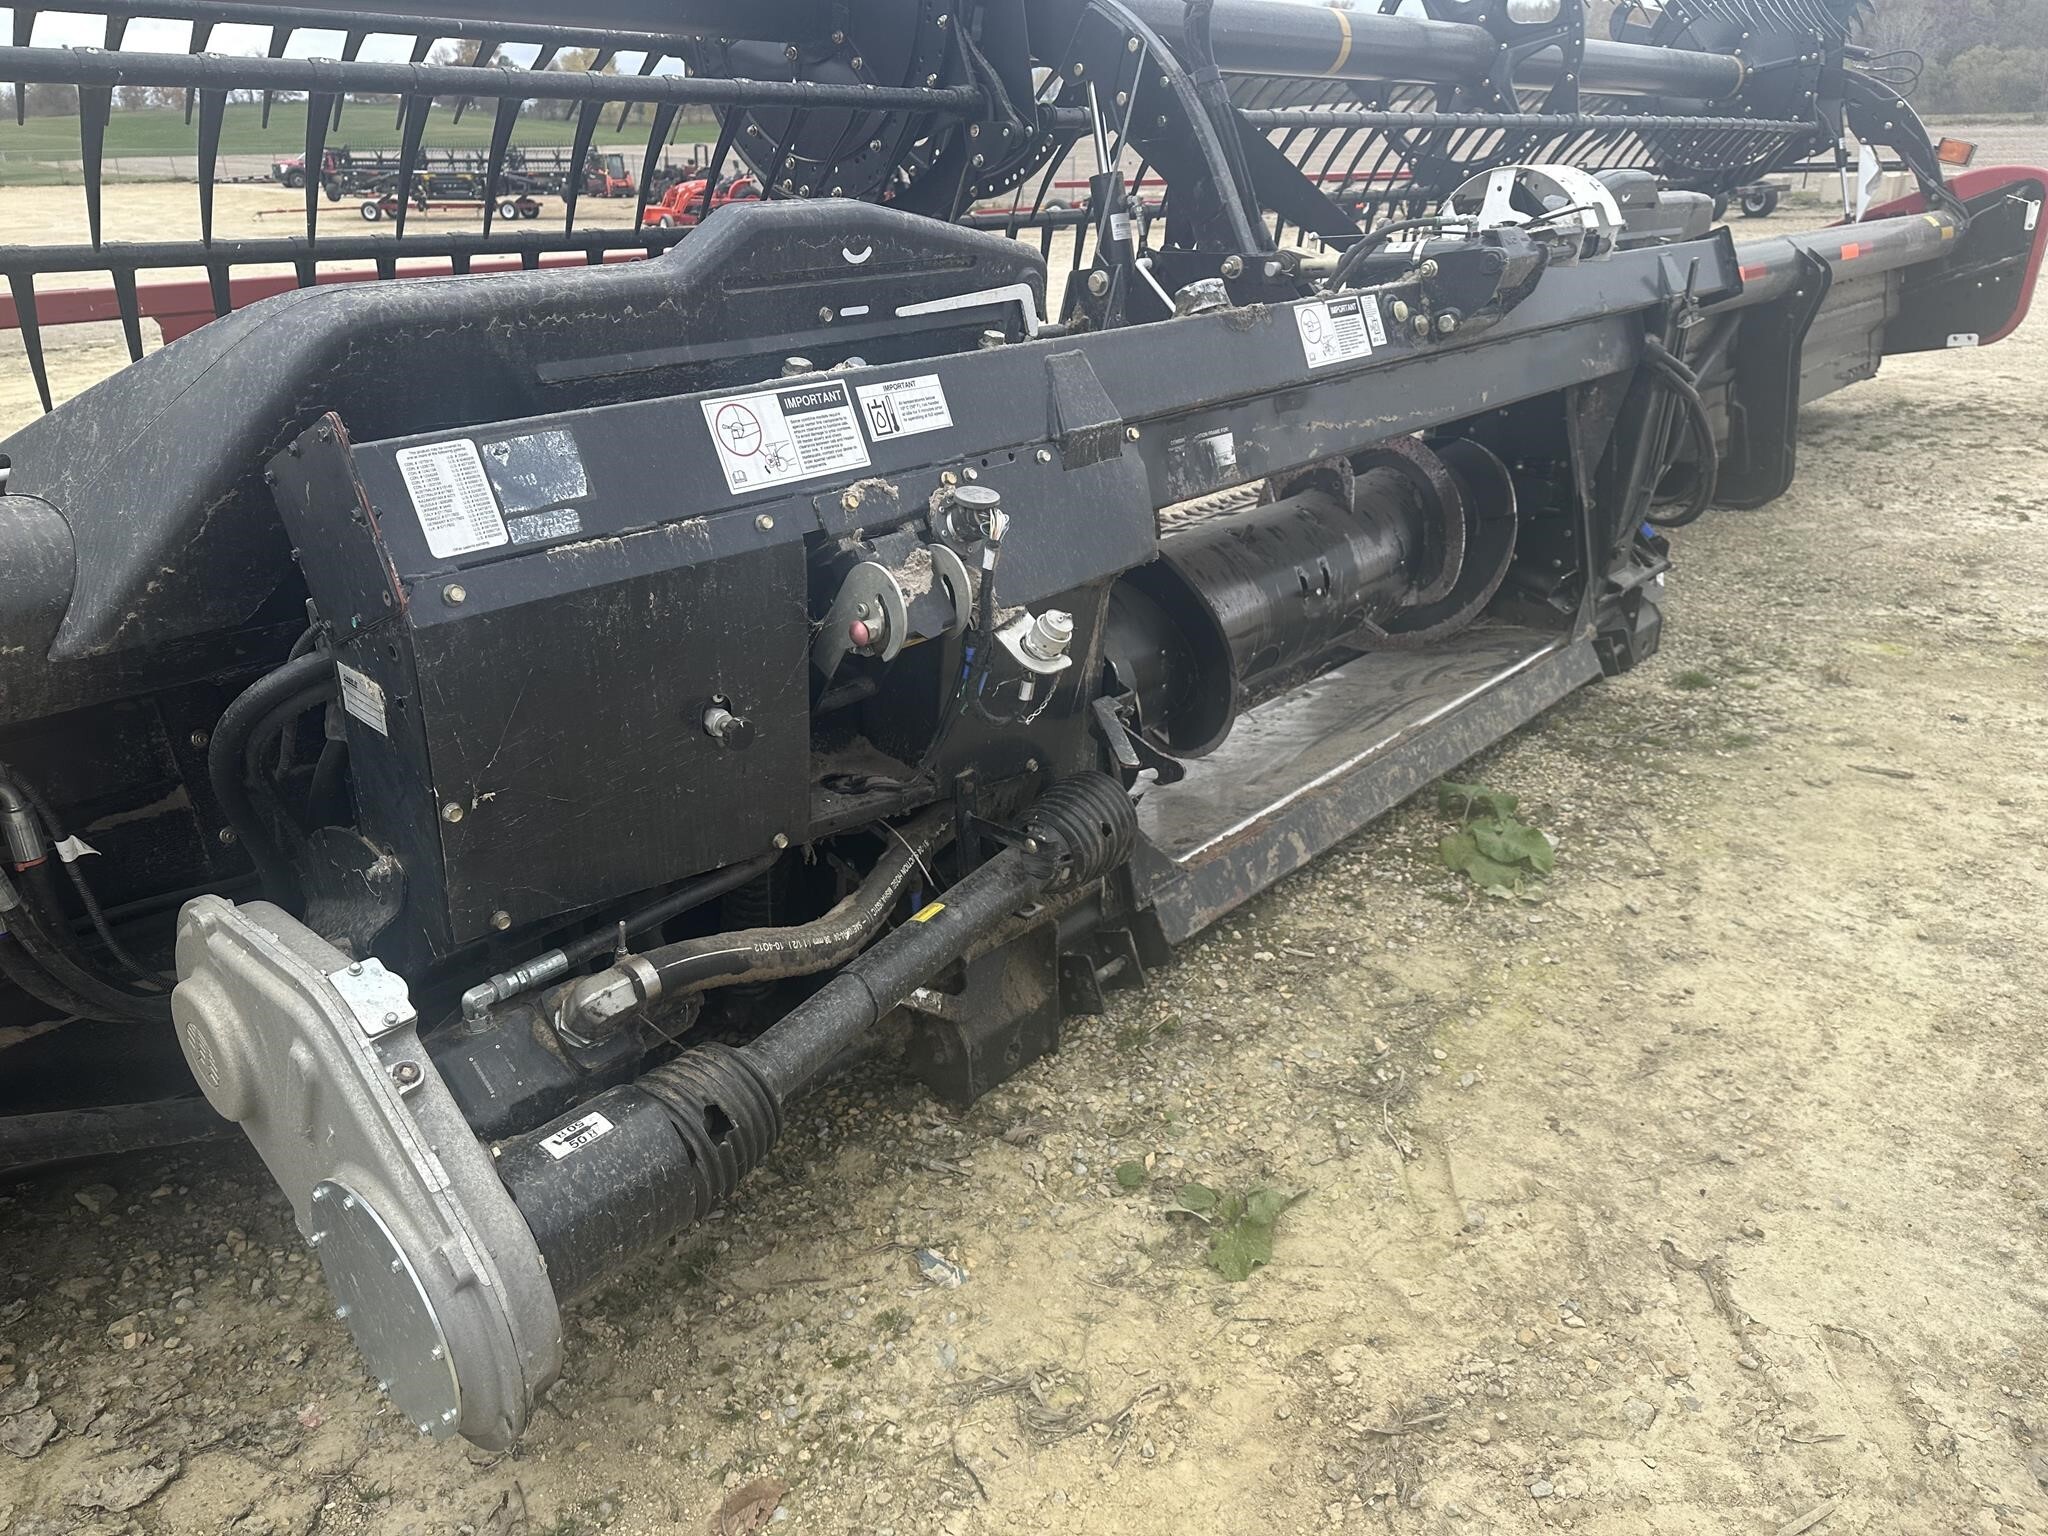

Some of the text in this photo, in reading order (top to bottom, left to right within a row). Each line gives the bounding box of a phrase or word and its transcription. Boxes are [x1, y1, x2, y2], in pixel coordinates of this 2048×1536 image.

[1329, 303, 1357, 315] IMPORTANT
[883, 380, 917, 392] IMPORTANT
[783, 389, 843, 410] IMPORTANT
[890, 872, 903, 890] HOSE
[569, 1135, 588, 1149] 50
